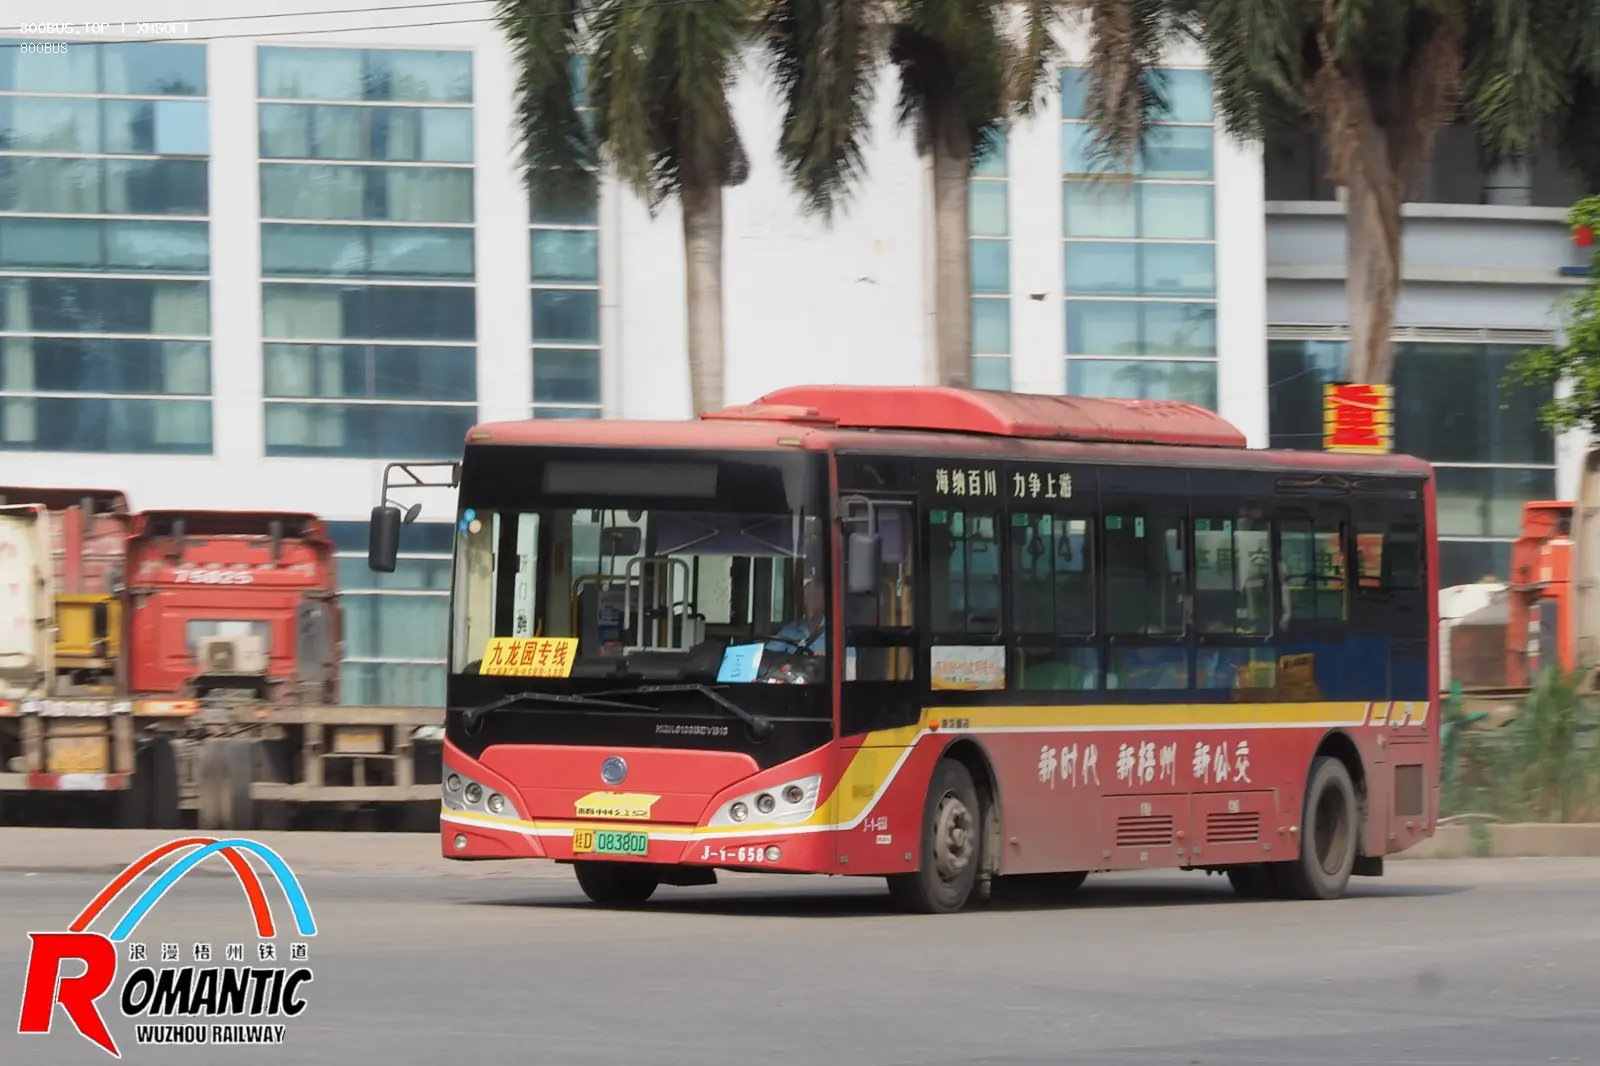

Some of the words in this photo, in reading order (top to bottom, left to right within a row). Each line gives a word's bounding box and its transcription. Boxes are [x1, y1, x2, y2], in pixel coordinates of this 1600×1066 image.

[936, 468, 997, 496] 海纳百川
[1013, 472, 1073, 499] 力争上游
[488, 640, 569, 667] 九龙园专线
[1038, 743, 1100, 789] 新时代
[1116, 740, 1177, 786] 新梧州
[1192, 740, 1253, 784] 新公交
[700, 845, 765, 862] J-1-658
